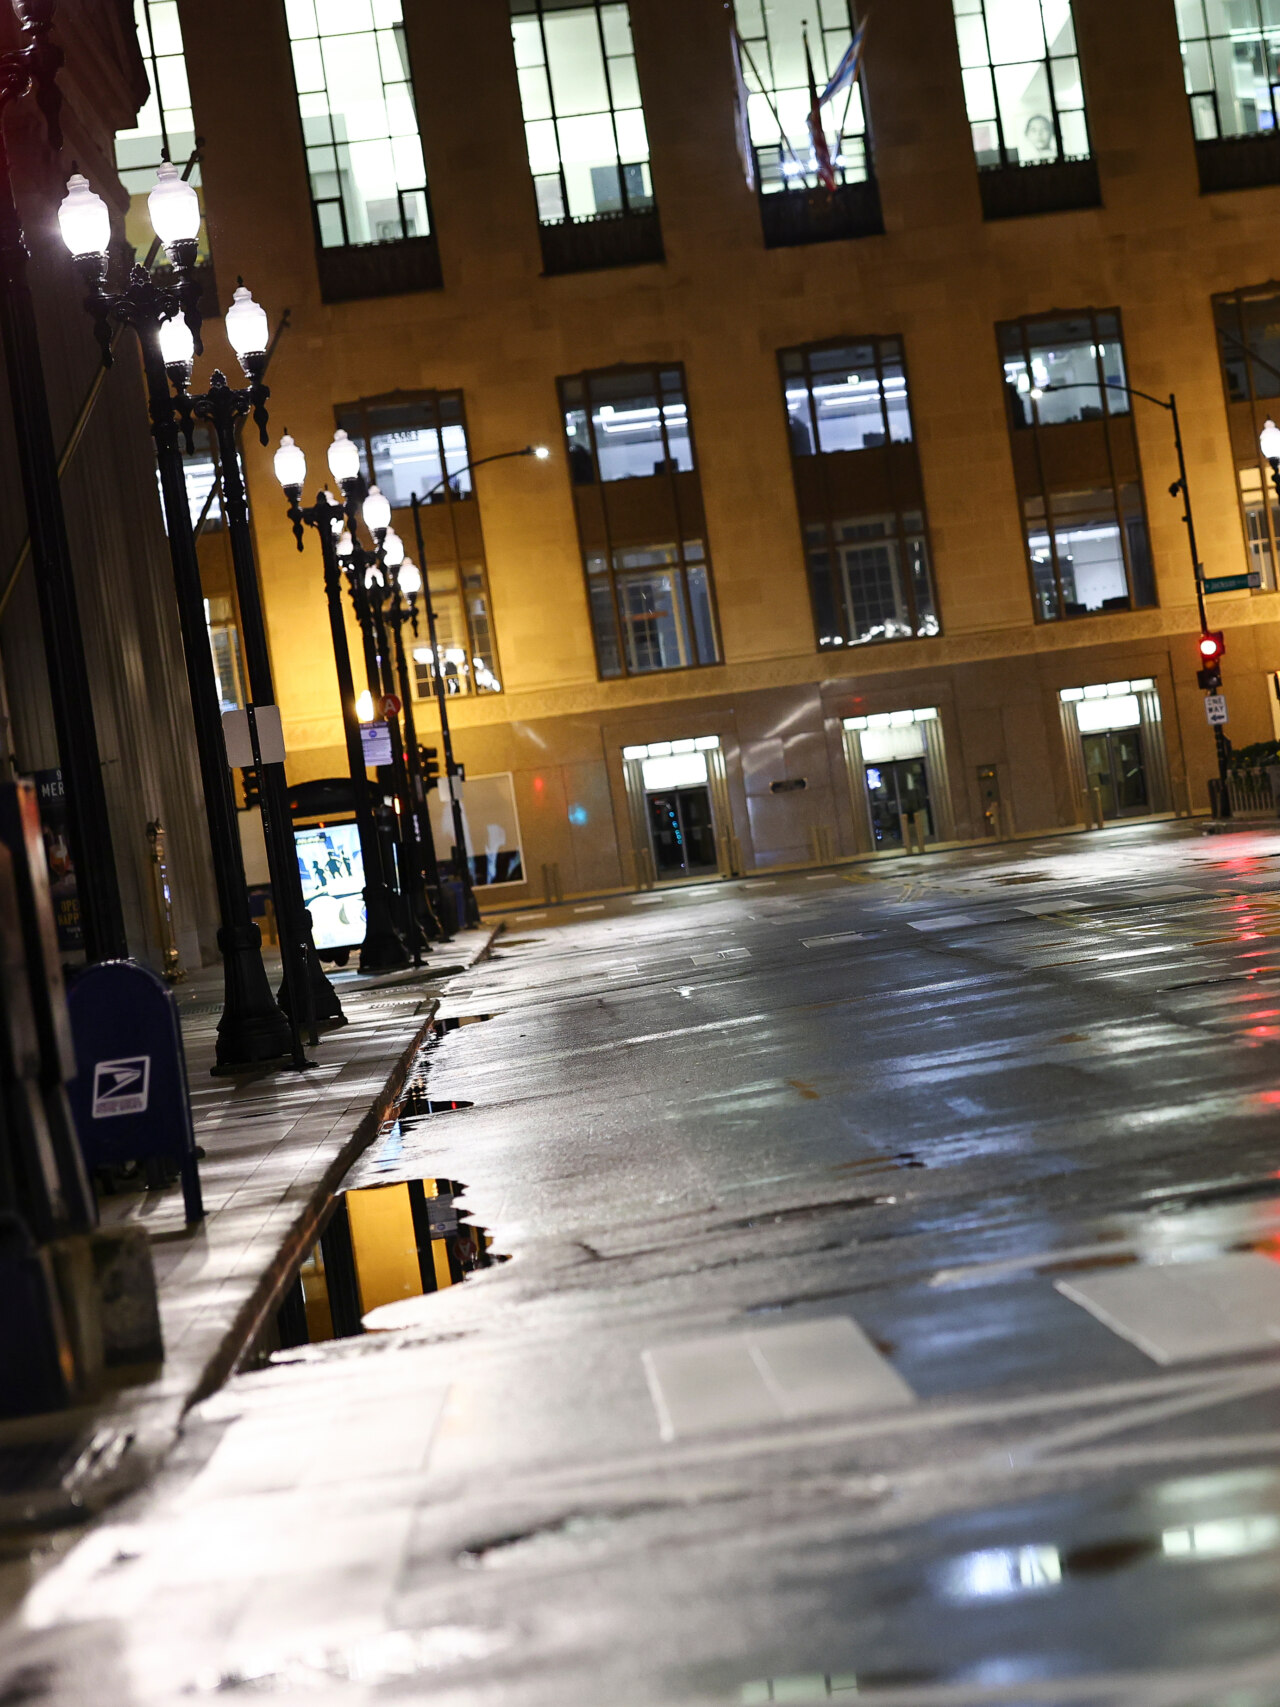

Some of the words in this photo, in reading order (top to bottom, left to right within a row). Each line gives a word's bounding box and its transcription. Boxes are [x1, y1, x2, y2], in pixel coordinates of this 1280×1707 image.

[384, 698, 397, 713] A
[41, 781, 65, 798] MER
[61, 898, 80, 912] OPE
